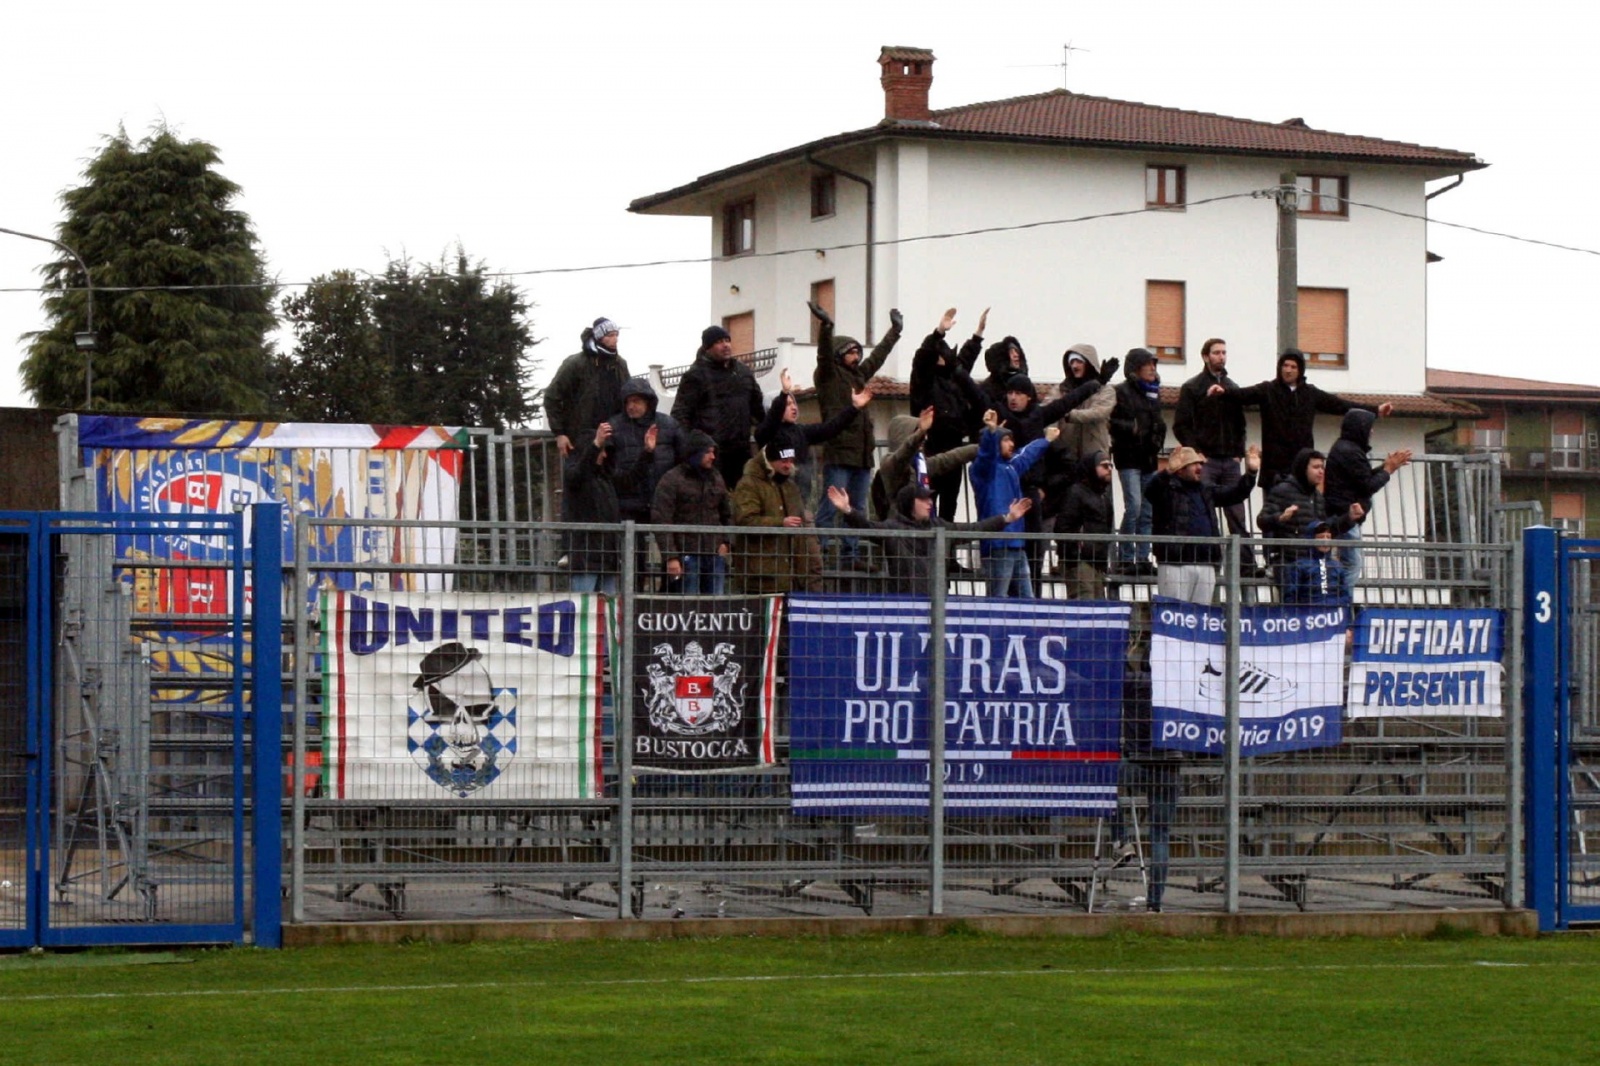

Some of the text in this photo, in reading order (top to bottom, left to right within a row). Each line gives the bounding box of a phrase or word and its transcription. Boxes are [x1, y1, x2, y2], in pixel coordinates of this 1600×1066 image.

[638, 607, 753, 631] GIOVENTÙ
[1161, 607, 1344, 636] one tem, one soul
[1535, 591, 1551, 623] 3
[350, 593, 576, 657] UNITED
[1368, 618, 1492, 656] DIFFIDATI
[688, 682, 702, 694] B
[1363, 670, 1486, 707] PRESENTI
[688, 701, 702, 712] B
[841, 700, 914, 744] PRO
[1162, 720, 1200, 741] pro
[1276, 715, 1325, 742] 1919
[635, 735, 750, 758] BUSTOCCA
